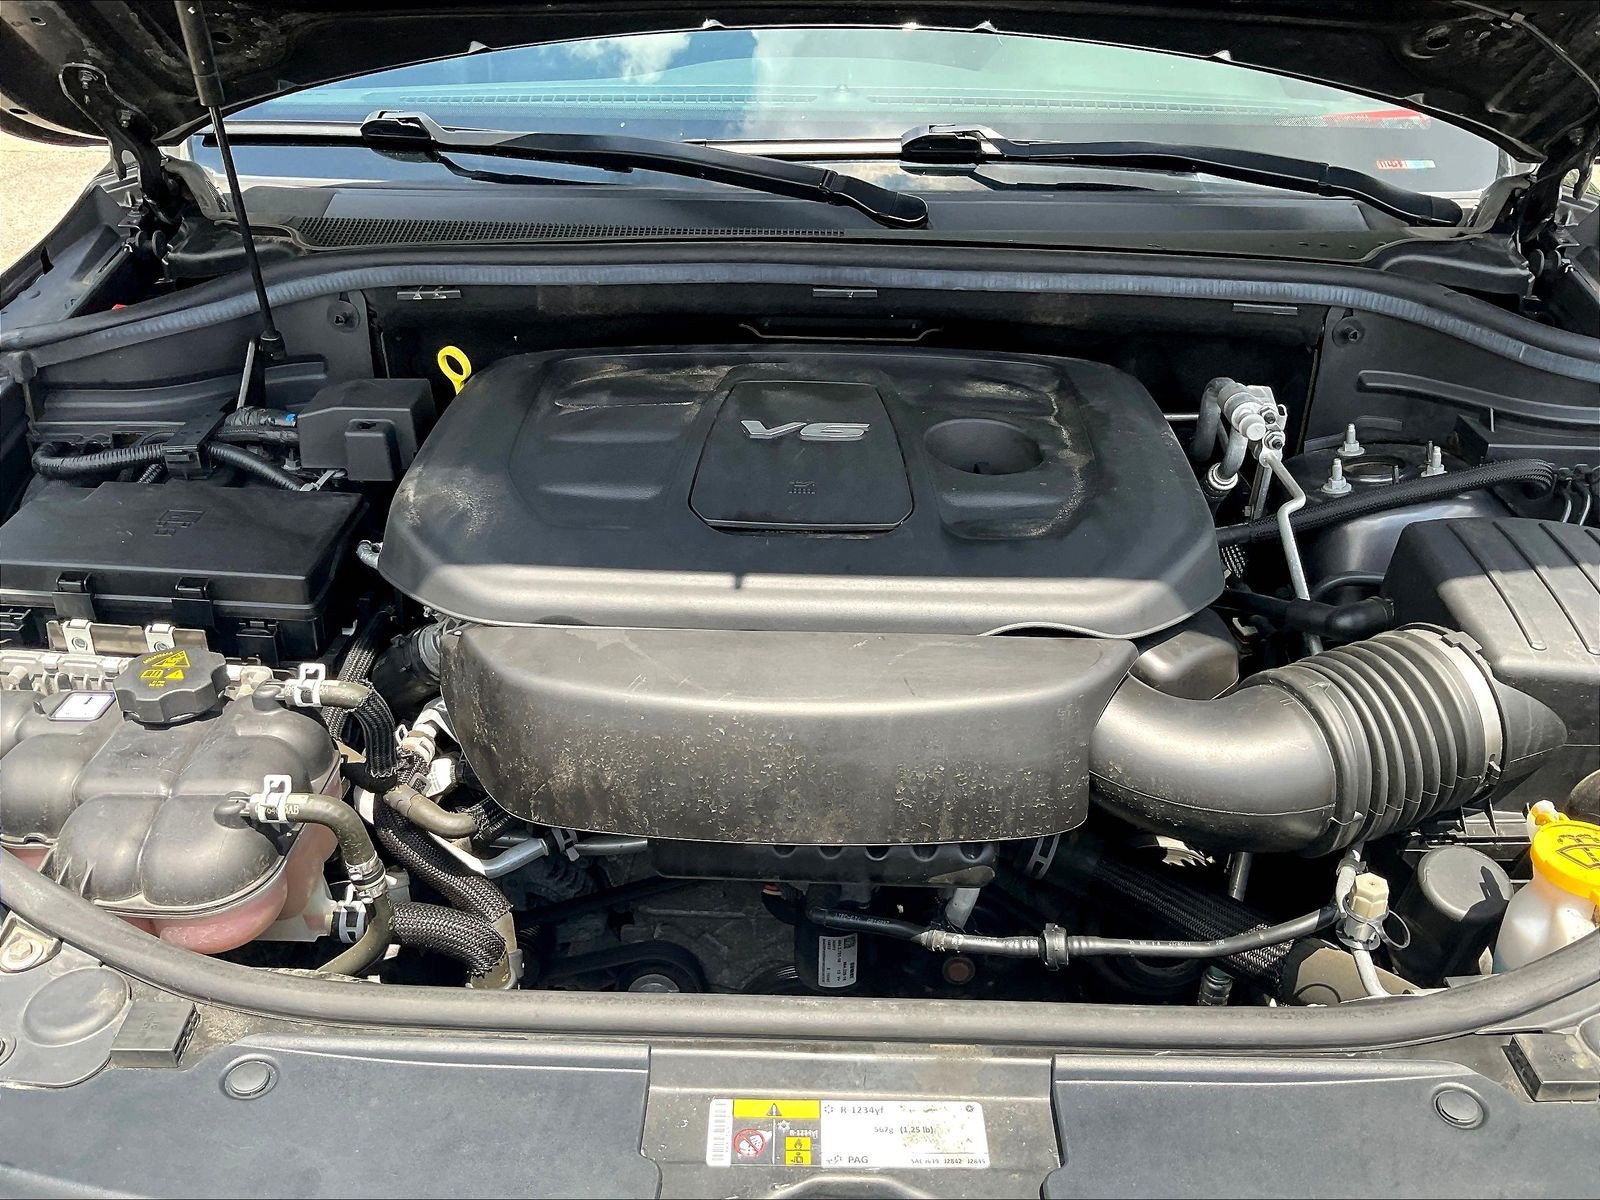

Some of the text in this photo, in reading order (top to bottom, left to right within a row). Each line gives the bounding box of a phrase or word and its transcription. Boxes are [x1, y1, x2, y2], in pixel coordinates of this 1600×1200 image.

[740, 419, 871, 442] V6
[851, 1106, 884, 1115] 1234yf
[848, 1155, 869, 1164] PAG
